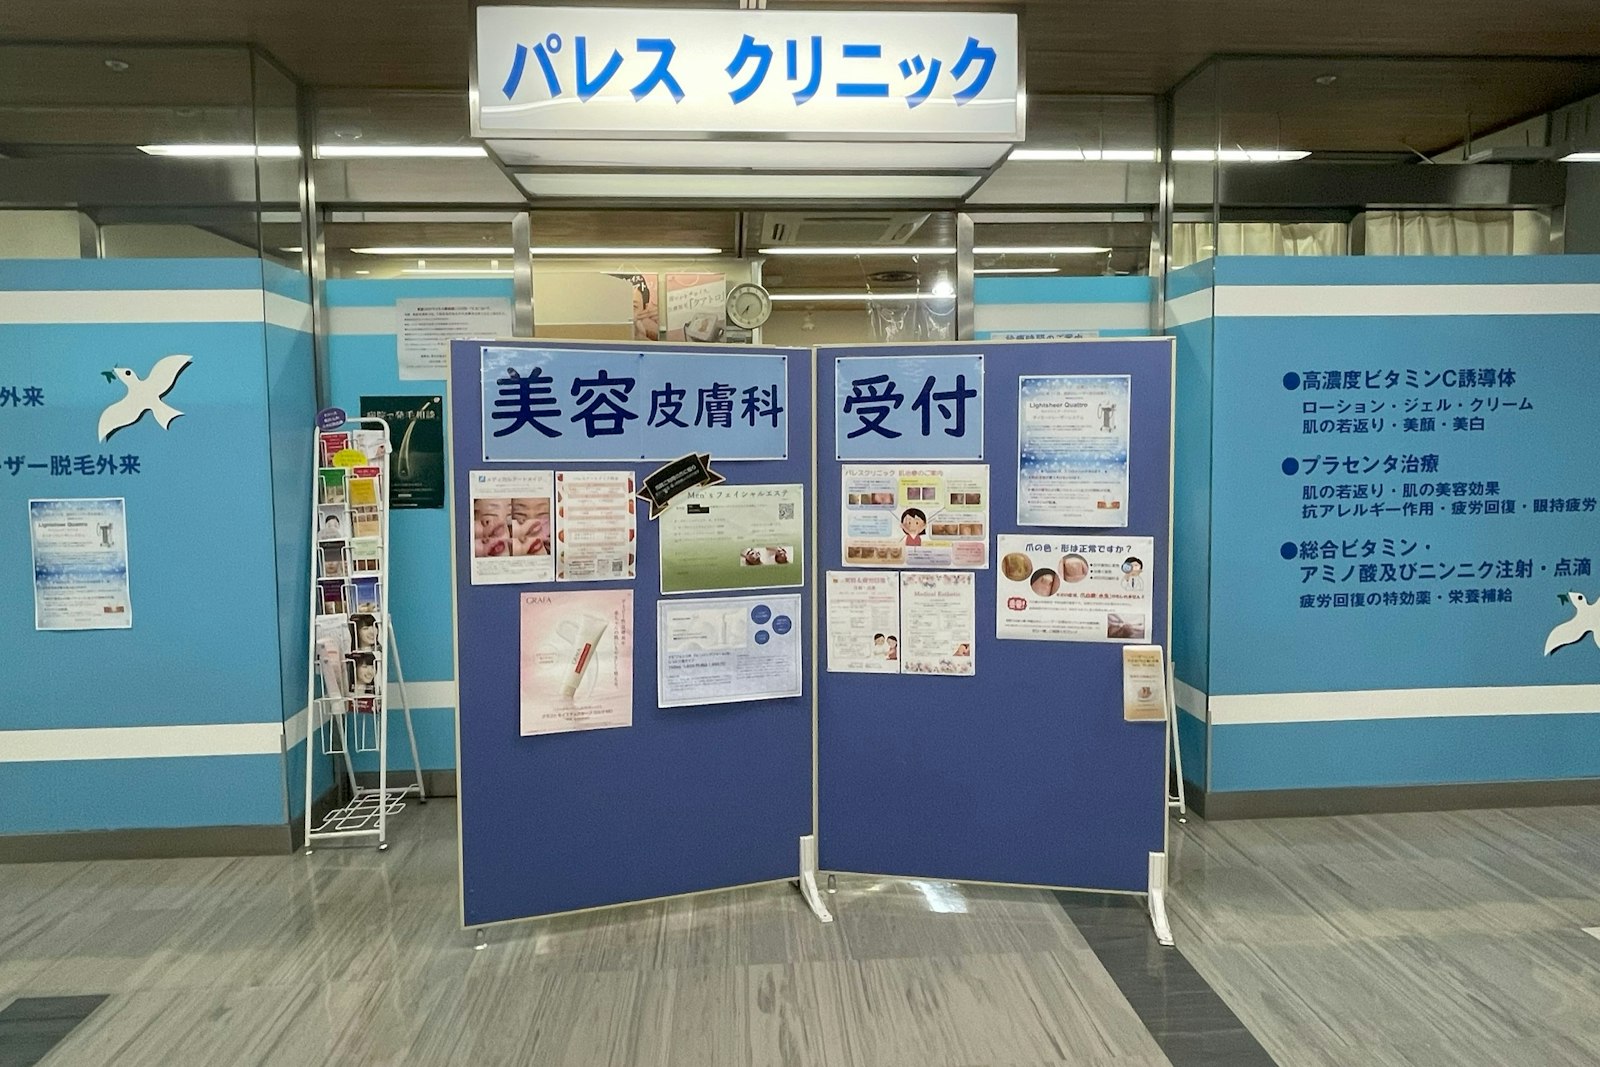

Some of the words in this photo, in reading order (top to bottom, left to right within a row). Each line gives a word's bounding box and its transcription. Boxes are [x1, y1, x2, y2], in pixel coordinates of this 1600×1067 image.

[502, 33, 686, 105] パレス
[725, 33, 998, 109] クリニック
[1302, 367, 1517, 391] 高濃度ビタミンC誘導体
[0, 386, 45, 408] 外来
[491, 366, 785, 439] 美容皮膚科
[842, 373, 978, 440] 受付
[1302, 397, 1534, 414] ローション・ジェル・クリーム
[1302, 417, 1486, 434] 肌の若返り・美顔・美白
[0, 453, 142, 477] ザー脱毛外来
[1301, 453, 1440, 476] プラセンタ治療
[1302, 481, 1501, 500] 肌の若返り・肌の美容効果
[1300, 557, 1592, 584] アミノ酸及びニンニク注射・点滴
[1299, 587, 1513, 608] 疲労回復の特効薬・栄養補給
